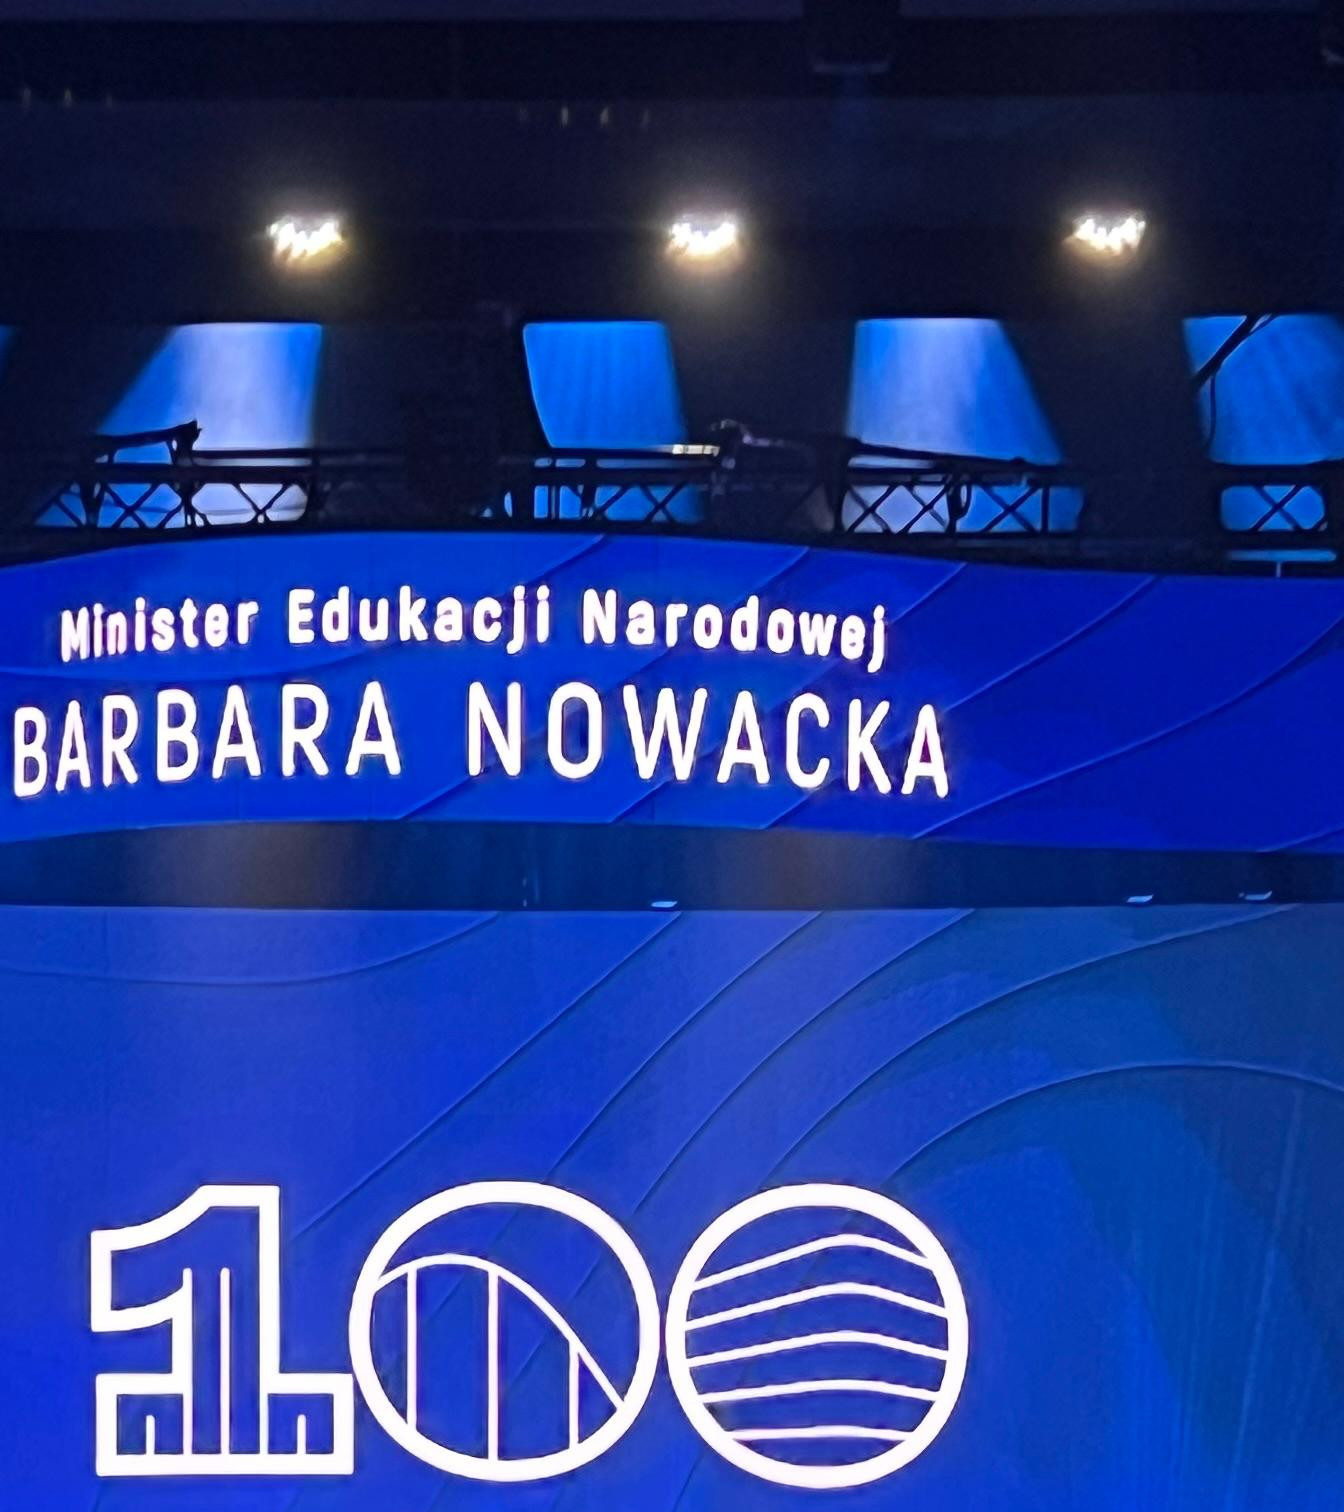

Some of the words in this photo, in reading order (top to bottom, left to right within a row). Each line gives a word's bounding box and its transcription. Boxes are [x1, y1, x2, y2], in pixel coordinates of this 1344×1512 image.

[59, 595, 260, 664] Minister
[287, 583, 551, 656] Edukacji
[581, 587, 887, 670] Narodowej
[12, 679, 403, 799] BARBARA
[467, 680, 950, 801] NOWACKA
[89, 1180, 970, 1491] 100
